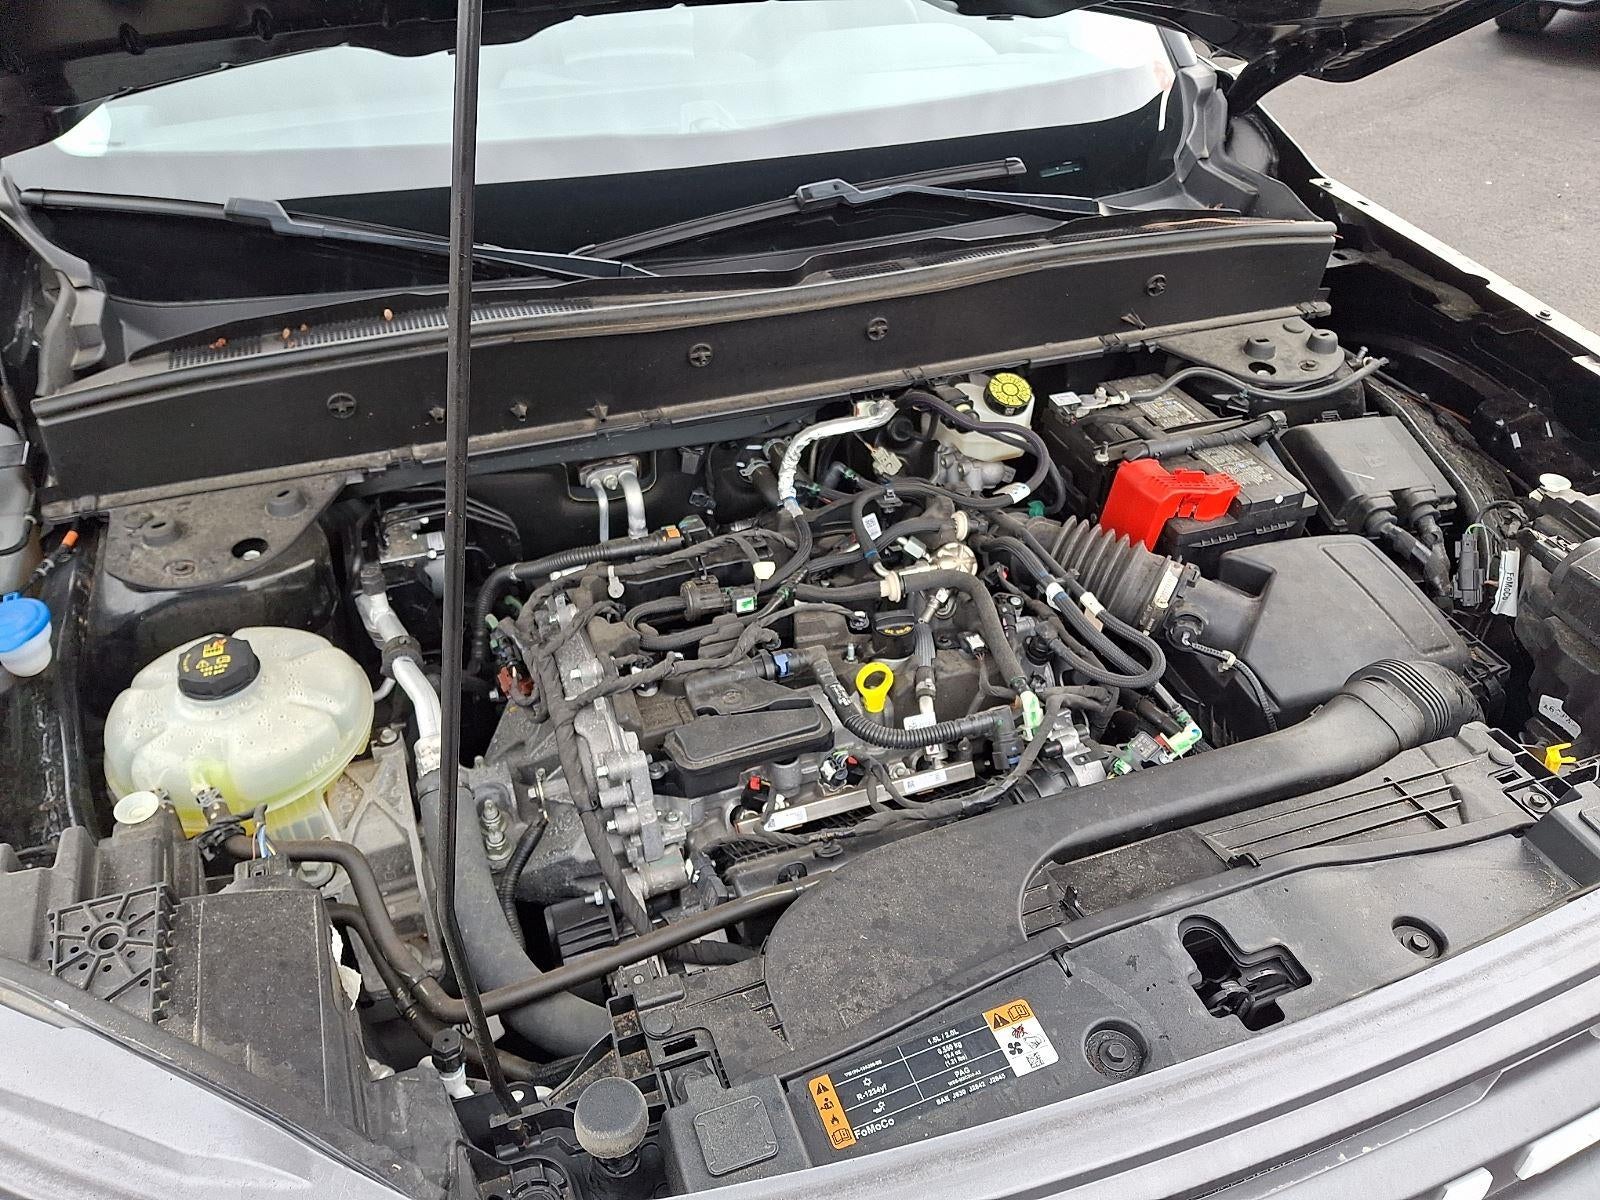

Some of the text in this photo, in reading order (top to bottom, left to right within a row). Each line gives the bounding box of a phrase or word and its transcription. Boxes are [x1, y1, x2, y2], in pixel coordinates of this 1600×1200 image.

[1502, 572, 1514, 600] FoMoCo
[945, 1028, 960, 1039] 2.0L
[954, 1067, 971, 1078] PAG
[856, 1083, 888, 1101] R-1234yf
[935, 1095, 950, 1106] SAE
[853, 1118, 895, 1140] FoMoCo
